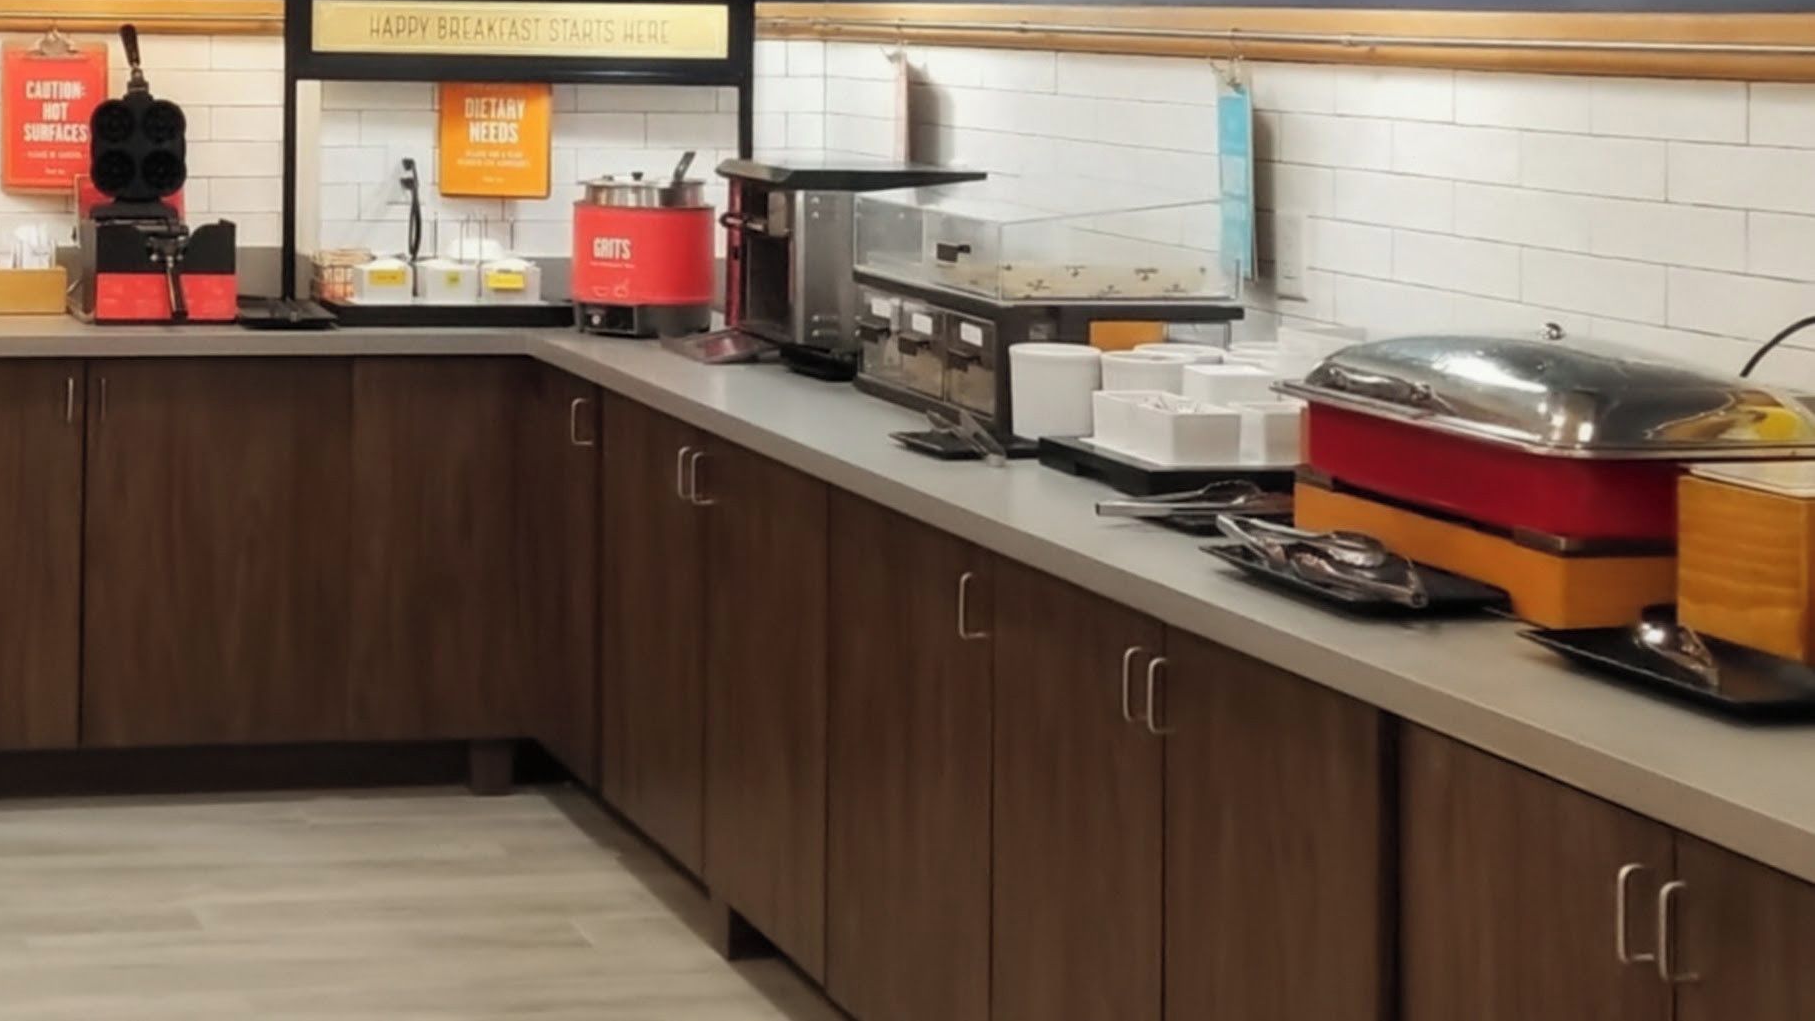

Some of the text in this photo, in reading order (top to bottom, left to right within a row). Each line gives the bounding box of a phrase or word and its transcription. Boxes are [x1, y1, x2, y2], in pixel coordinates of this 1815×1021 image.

[369, 14, 671, 45] HAPPY BREAKFAST STARTS HERE
[25, 80, 85, 100] CAUTION:
[42, 101, 69, 121] HOT
[465, 97, 526, 120] DIETARY
[23, 123, 88, 142] SURFACES
[469, 121, 519, 145] NEEDS
[593, 237, 631, 260] GRITS
